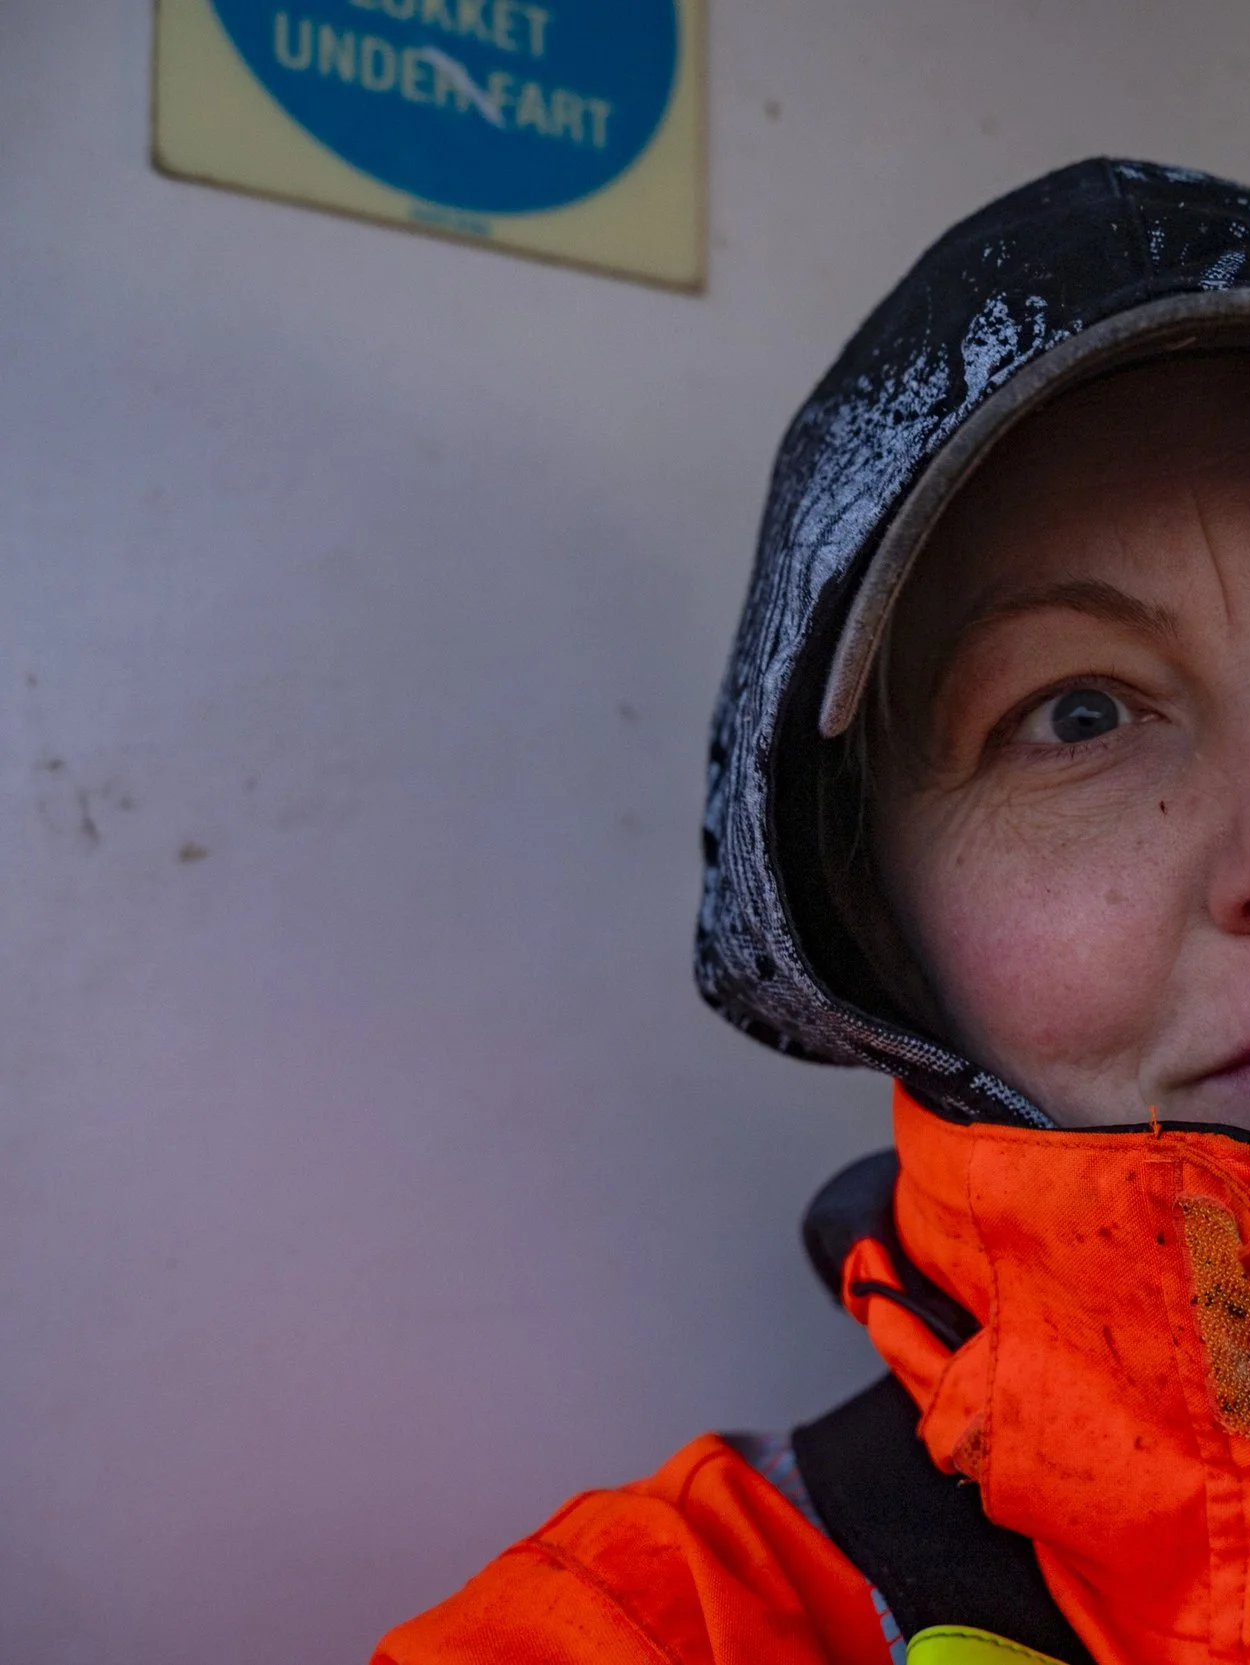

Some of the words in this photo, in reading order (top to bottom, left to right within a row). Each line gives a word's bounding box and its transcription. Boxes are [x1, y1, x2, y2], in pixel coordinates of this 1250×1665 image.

[348, 0, 550, 57] KKET
[273, 12, 471, 113] UNDER
[486, 72, 613, 148] FART
